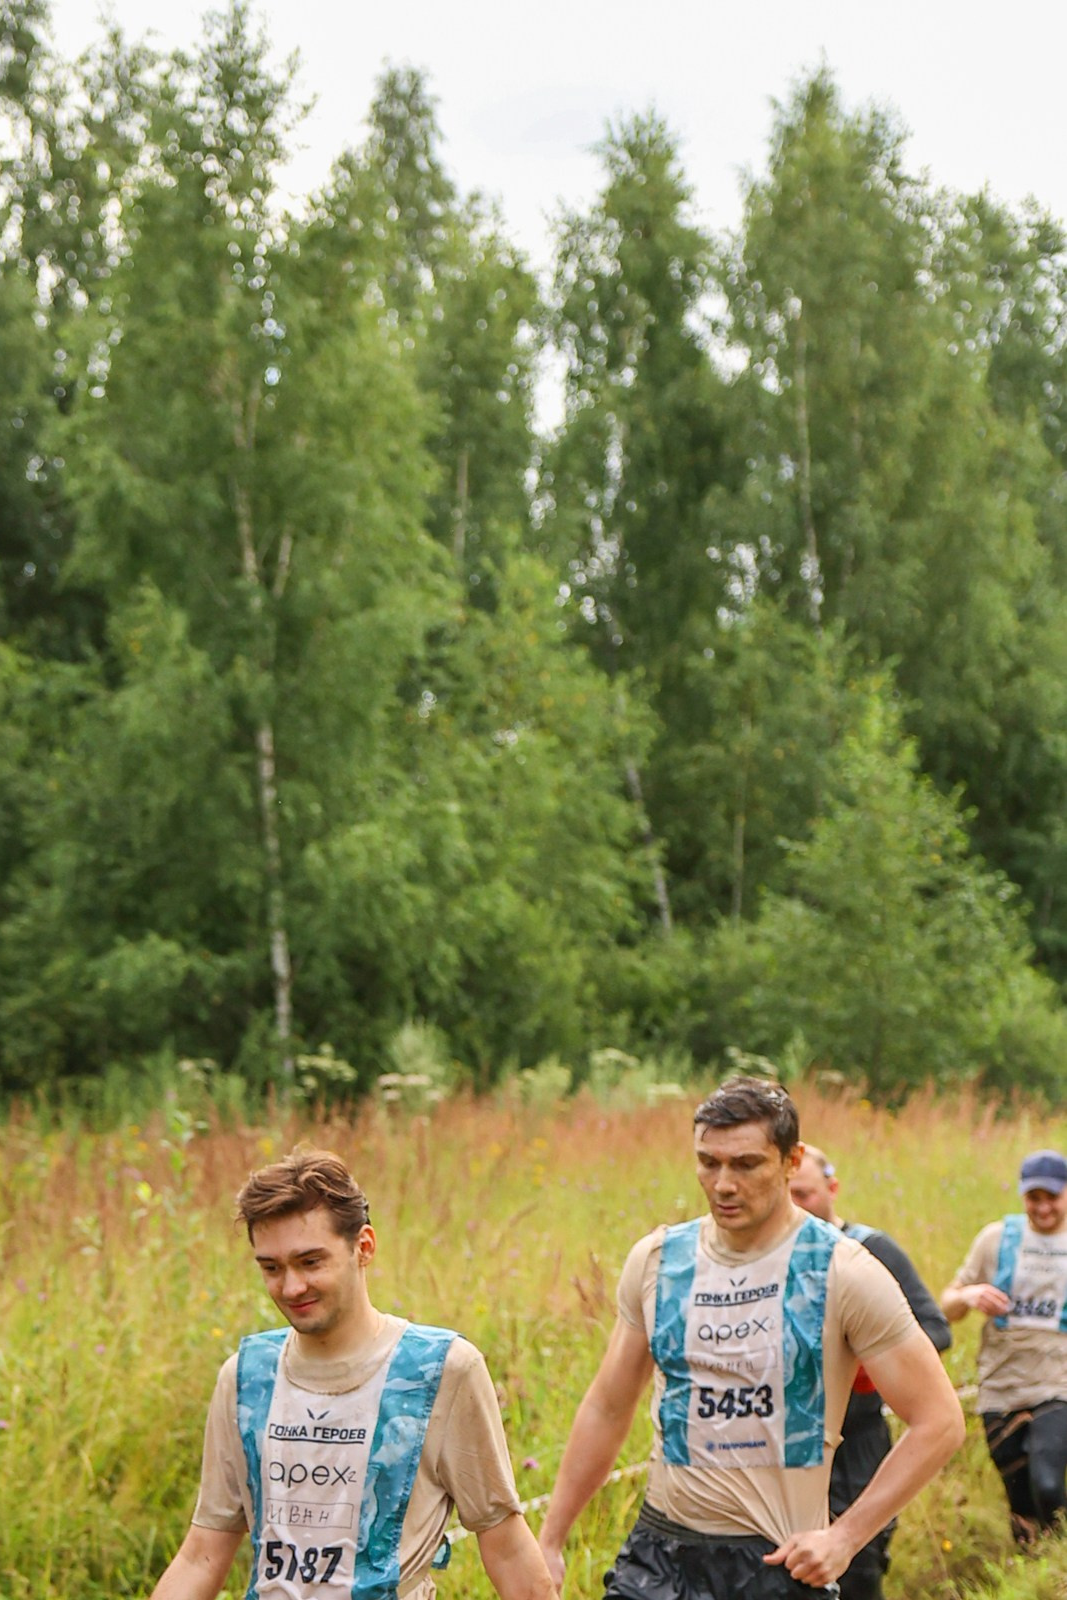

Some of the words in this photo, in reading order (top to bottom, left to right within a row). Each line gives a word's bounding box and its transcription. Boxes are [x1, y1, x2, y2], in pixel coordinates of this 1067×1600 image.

[695, 1292, 731, 1304] ГОНКА
[735, 1283, 779, 1302] ГЕРОЕВ
[698, 1384, 774, 1420] 5453
[268, 1423, 308, 1438] ГОНКА
[312, 1426, 367, 1441] ГЕРОЕВ
[265, 1540, 343, 1584] 5187
